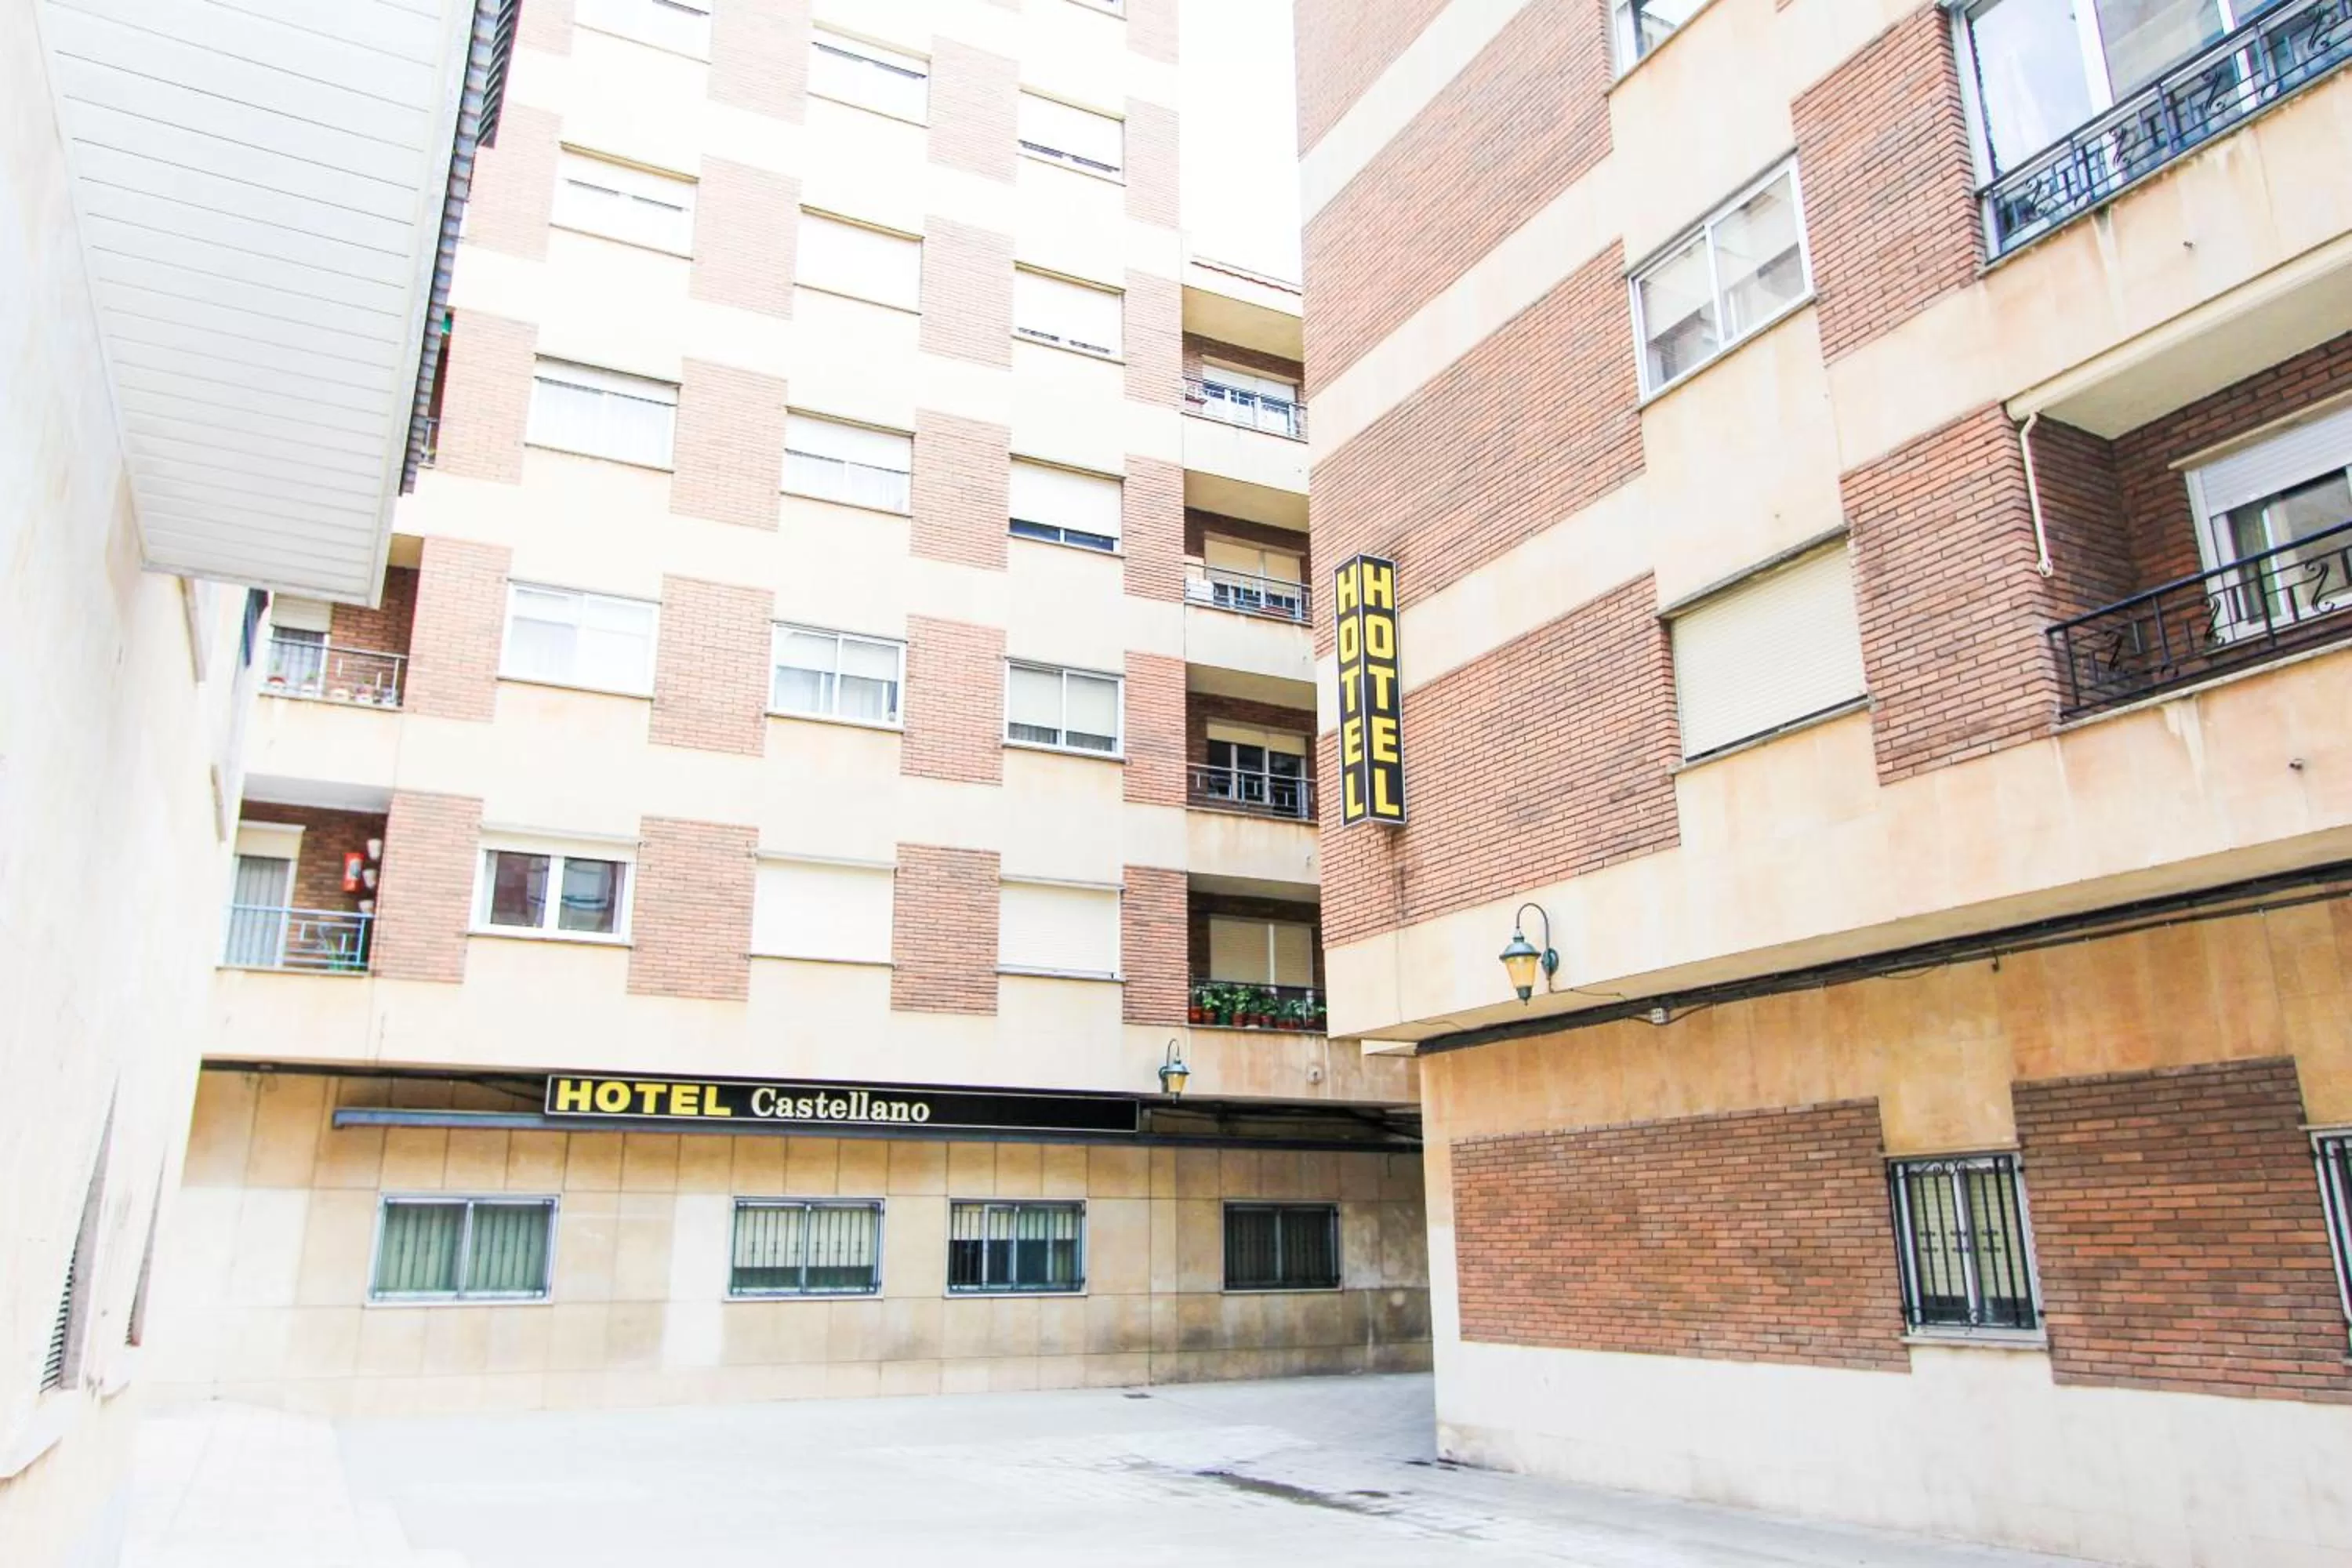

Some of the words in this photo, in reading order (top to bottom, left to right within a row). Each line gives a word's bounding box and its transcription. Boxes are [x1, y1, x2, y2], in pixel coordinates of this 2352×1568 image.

[1338, 564, 1363, 819] HOTEL
[1362, 563, 1399, 816] HOTEL
[555, 1080, 731, 1117] HOTEL
[750, 1087, 931, 1123] Castellano
